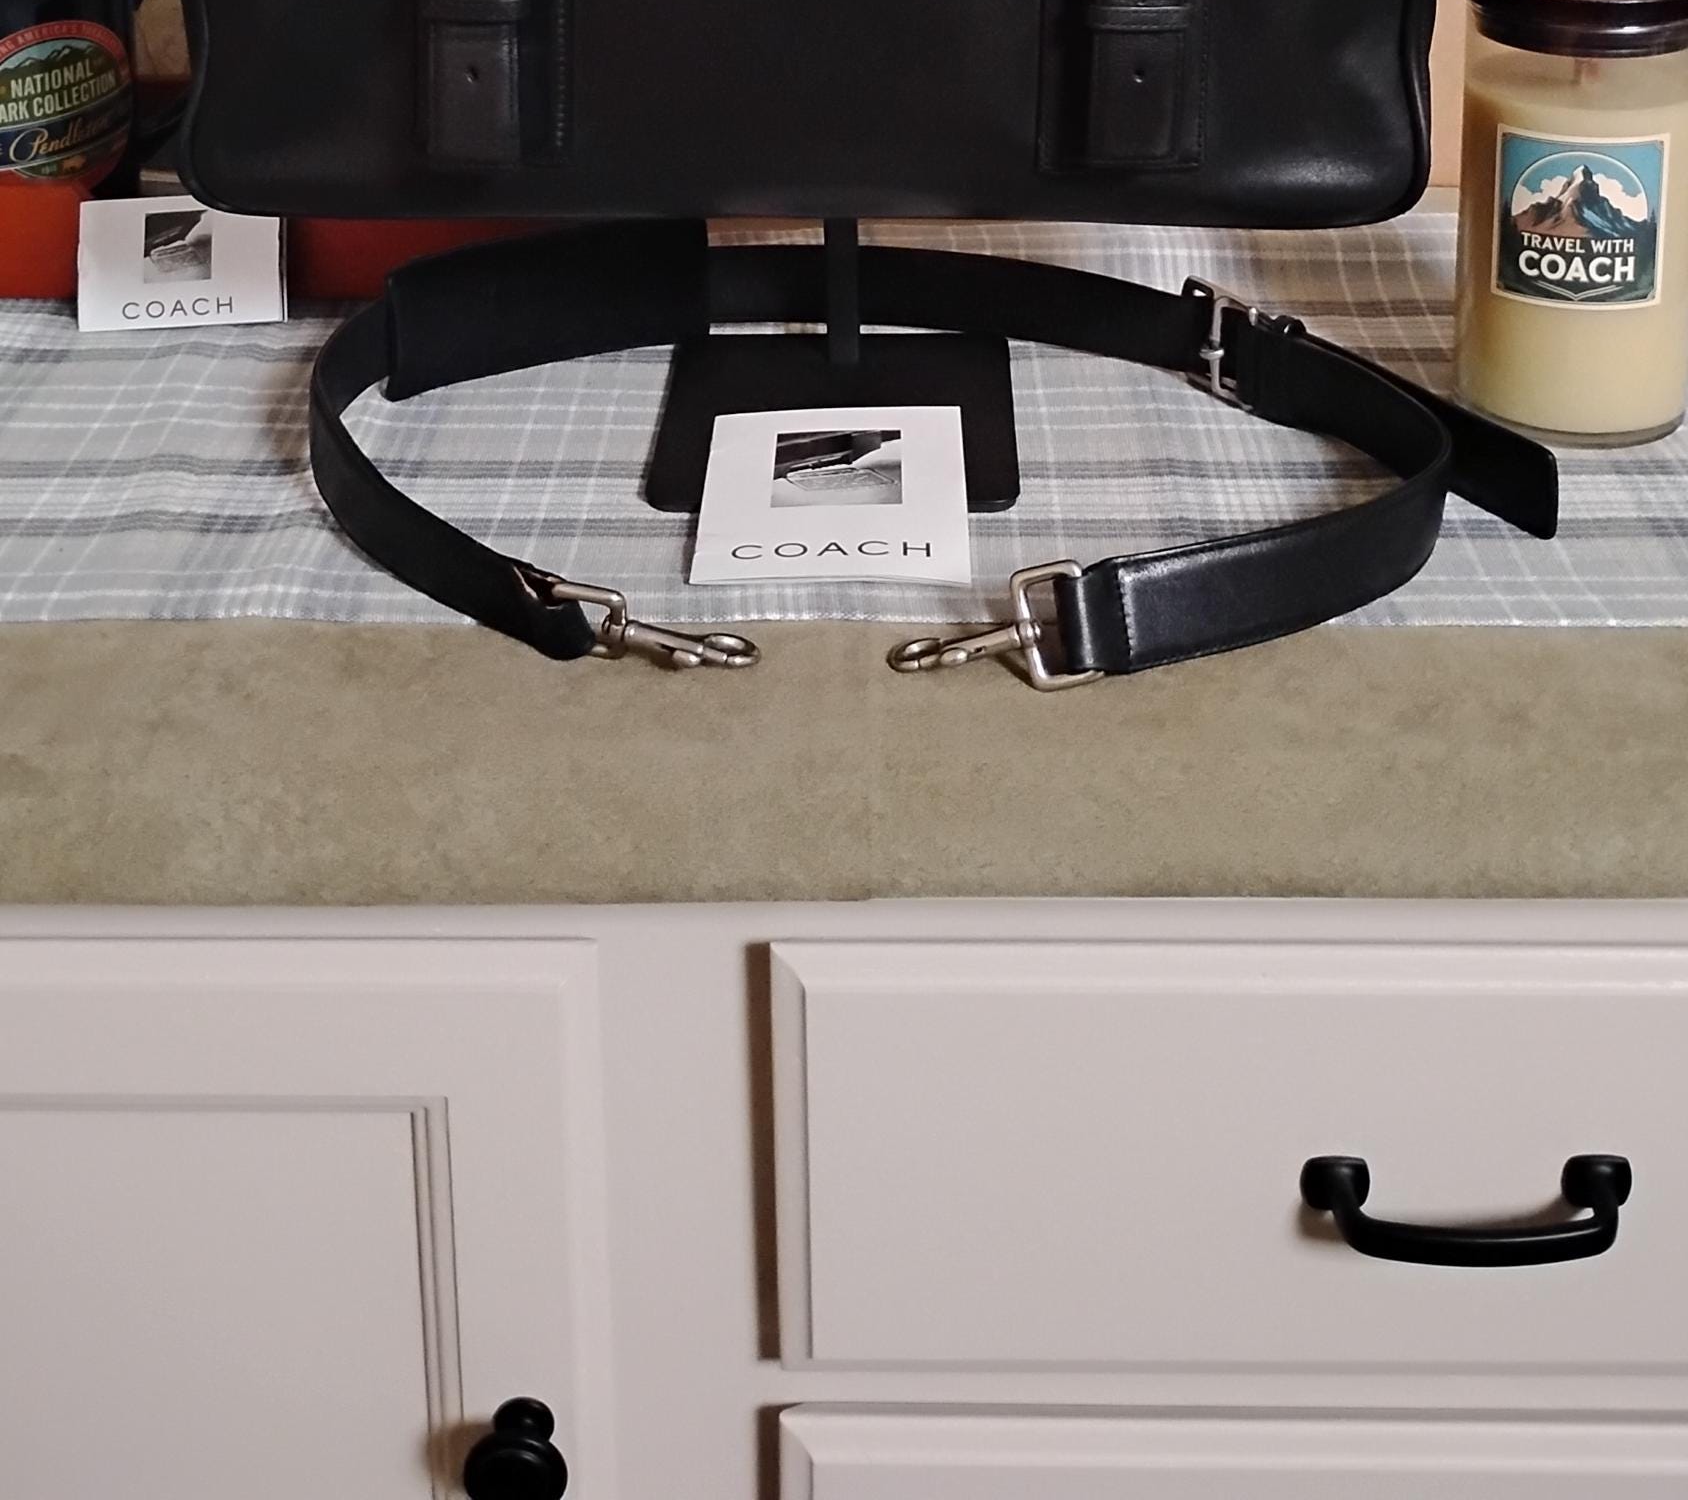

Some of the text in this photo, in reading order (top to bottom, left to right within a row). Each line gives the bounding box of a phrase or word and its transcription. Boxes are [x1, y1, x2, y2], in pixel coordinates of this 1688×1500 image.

[10, 58, 94, 99] NATIONAL
[33, 70, 117, 117] COLLECTION
[8, 115, 110, 164] Pendl
[1520, 231, 1635, 254] TRAVEL WITH
[1518, 250, 1636, 283] COACH
[122, 296, 233, 320] COACH
[730, 540, 932, 560] COACH
